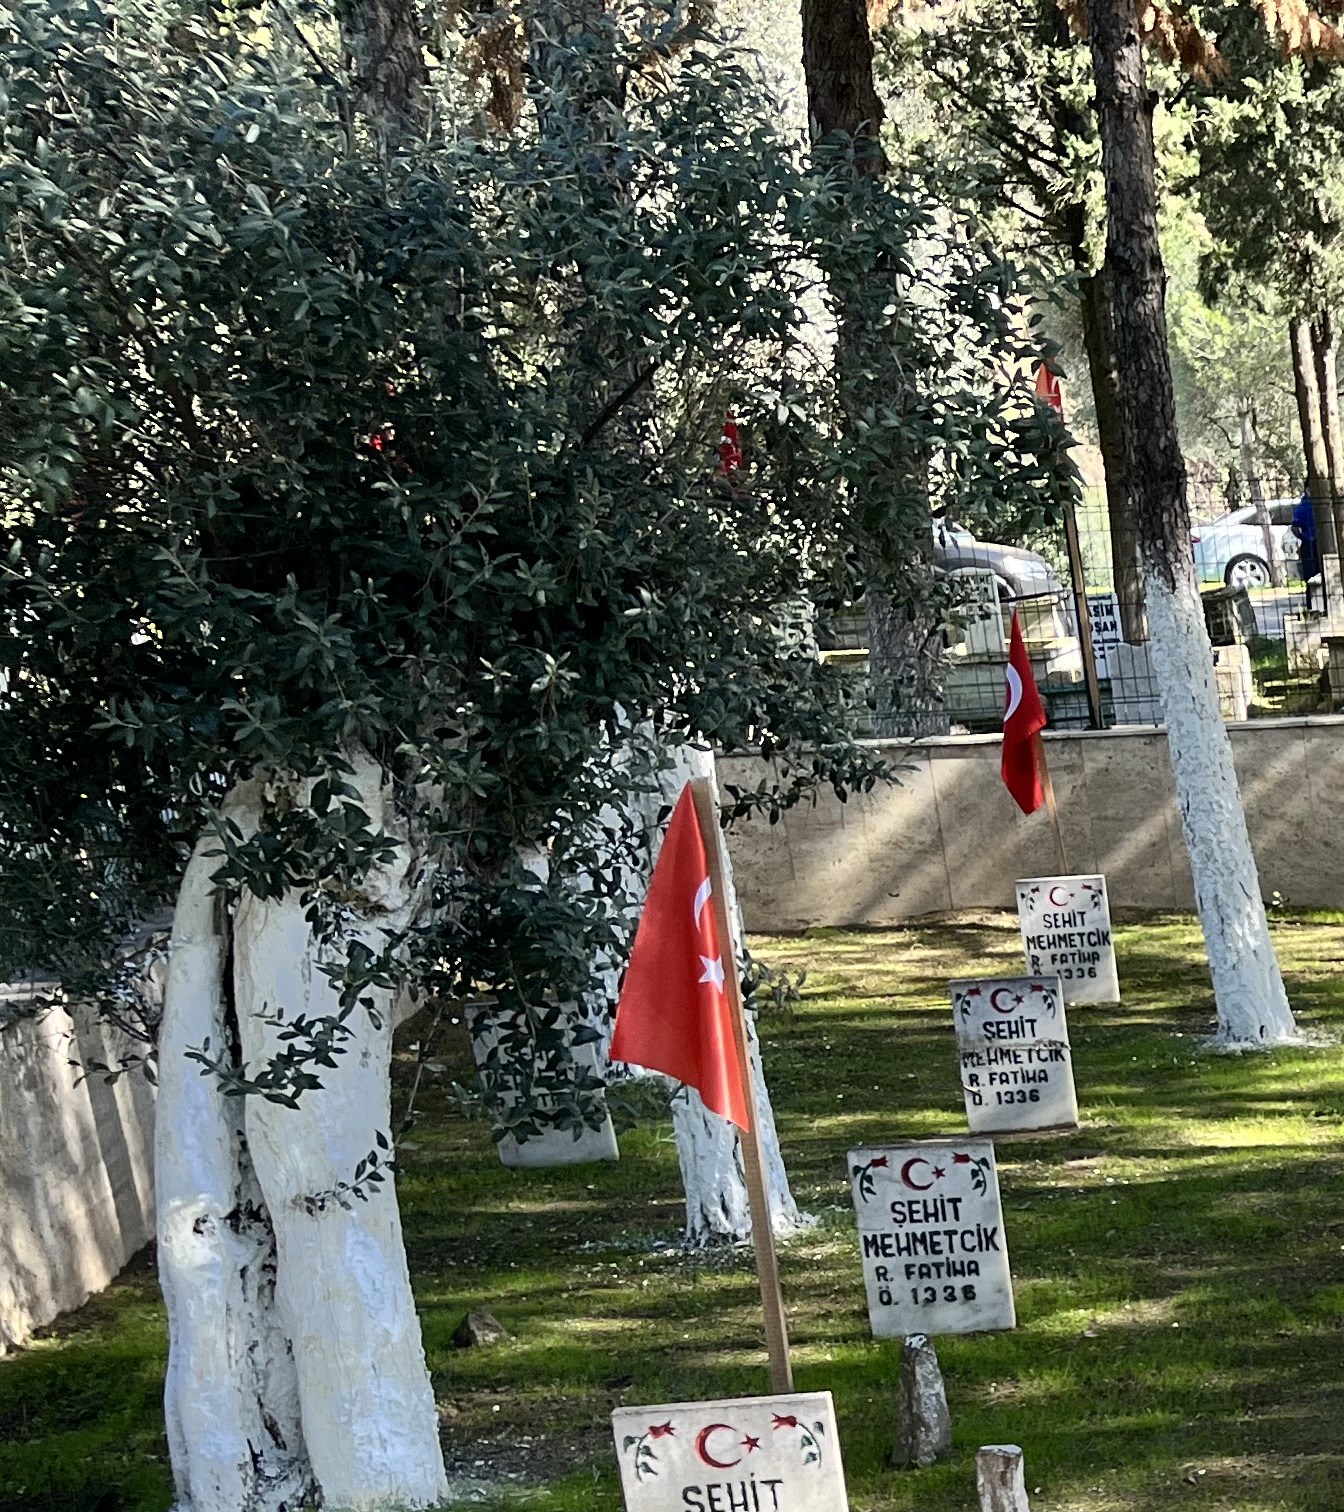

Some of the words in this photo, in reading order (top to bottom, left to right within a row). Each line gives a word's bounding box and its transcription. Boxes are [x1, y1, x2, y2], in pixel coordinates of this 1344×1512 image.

[996, 1089, 1040, 1105] 1336
[891, 1194, 962, 1228] ŞEHİT
[863, 1224, 1000, 1258] MEHMETCİK
[875, 1265, 894, 1282] R.
[905, 1257, 980, 1280] FATİHA
[879, 1286, 898, 1306] Ö.
[911, 1284, 976, 1304] 1336
